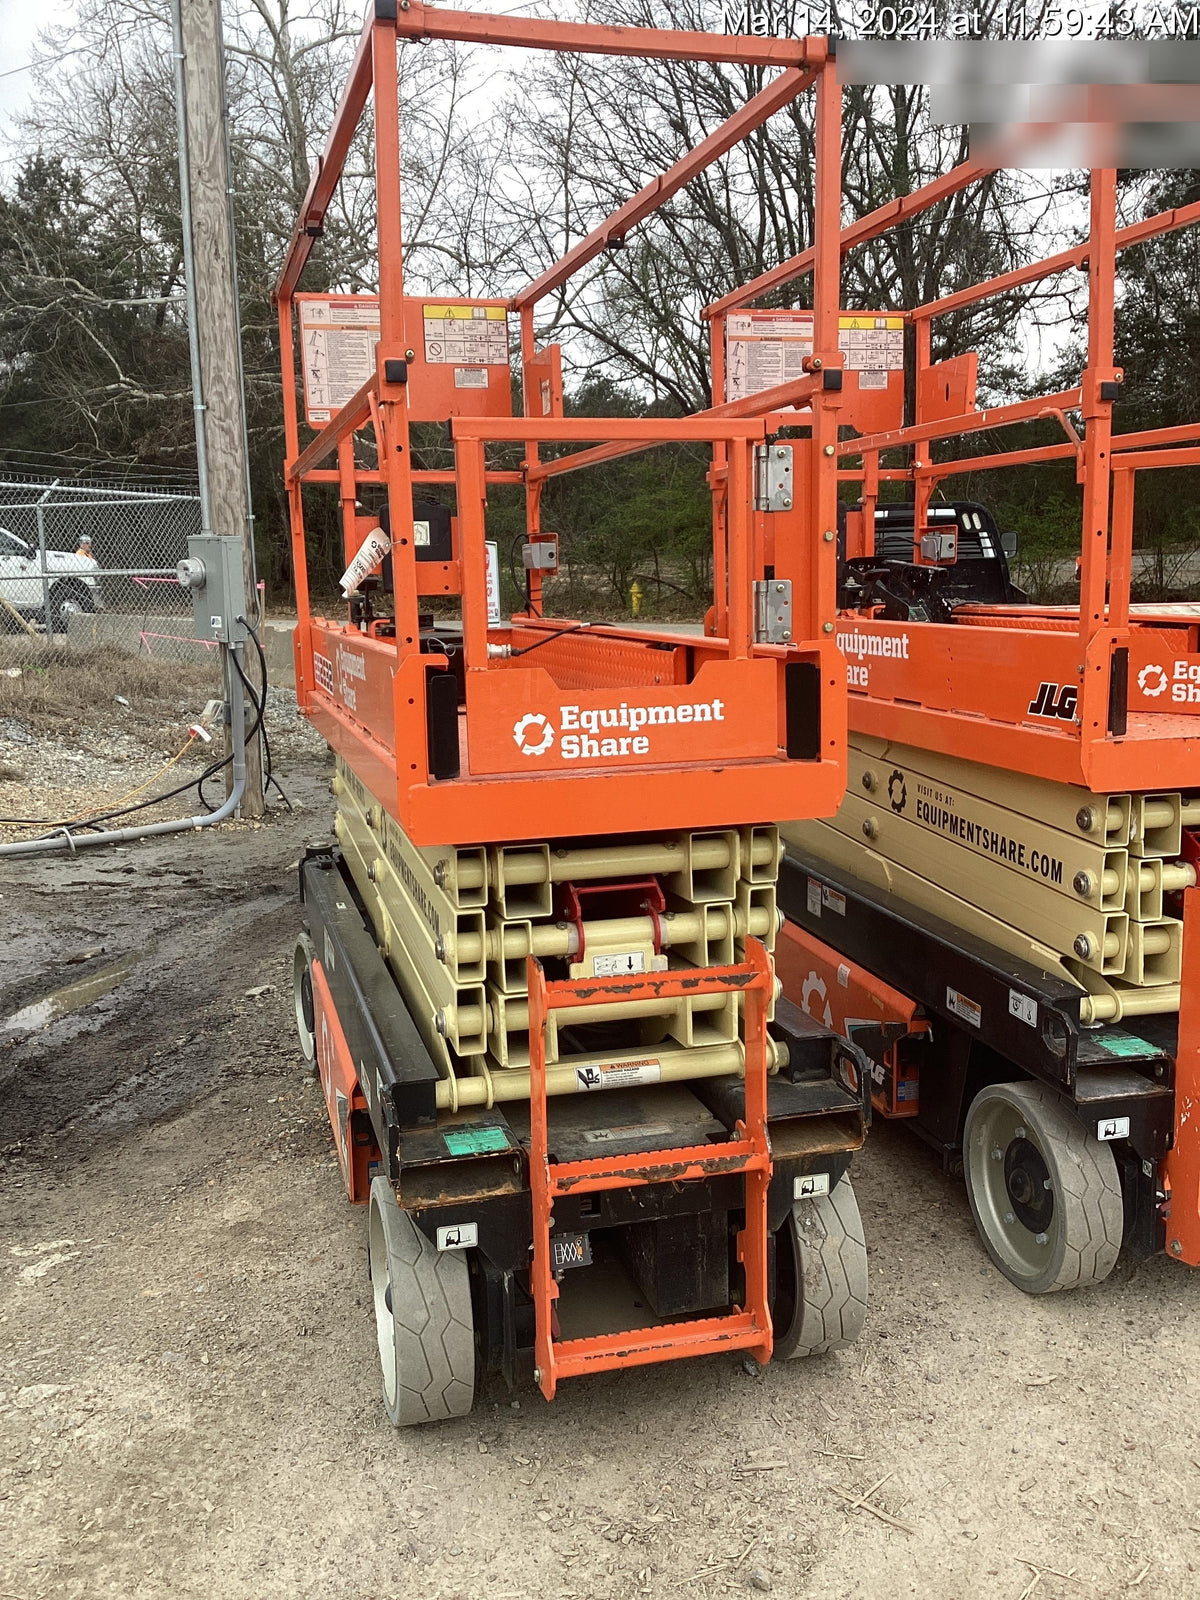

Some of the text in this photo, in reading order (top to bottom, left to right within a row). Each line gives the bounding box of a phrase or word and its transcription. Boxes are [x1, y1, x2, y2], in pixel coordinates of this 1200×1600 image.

[836, 628, 909, 660] quipment
[559, 698, 725, 734] Equipment
[1027, 681, 1078, 721] JLG
[560, 734, 649, 759] Share
[916, 783, 933, 799] VISIT
[934, 791, 943, 803] US
[916, 799, 1063, 884] EQUIPMENTSHARE.COM
[617, 1060, 649, 1069] WARNING
[867, 1056, 886, 1086] LG
